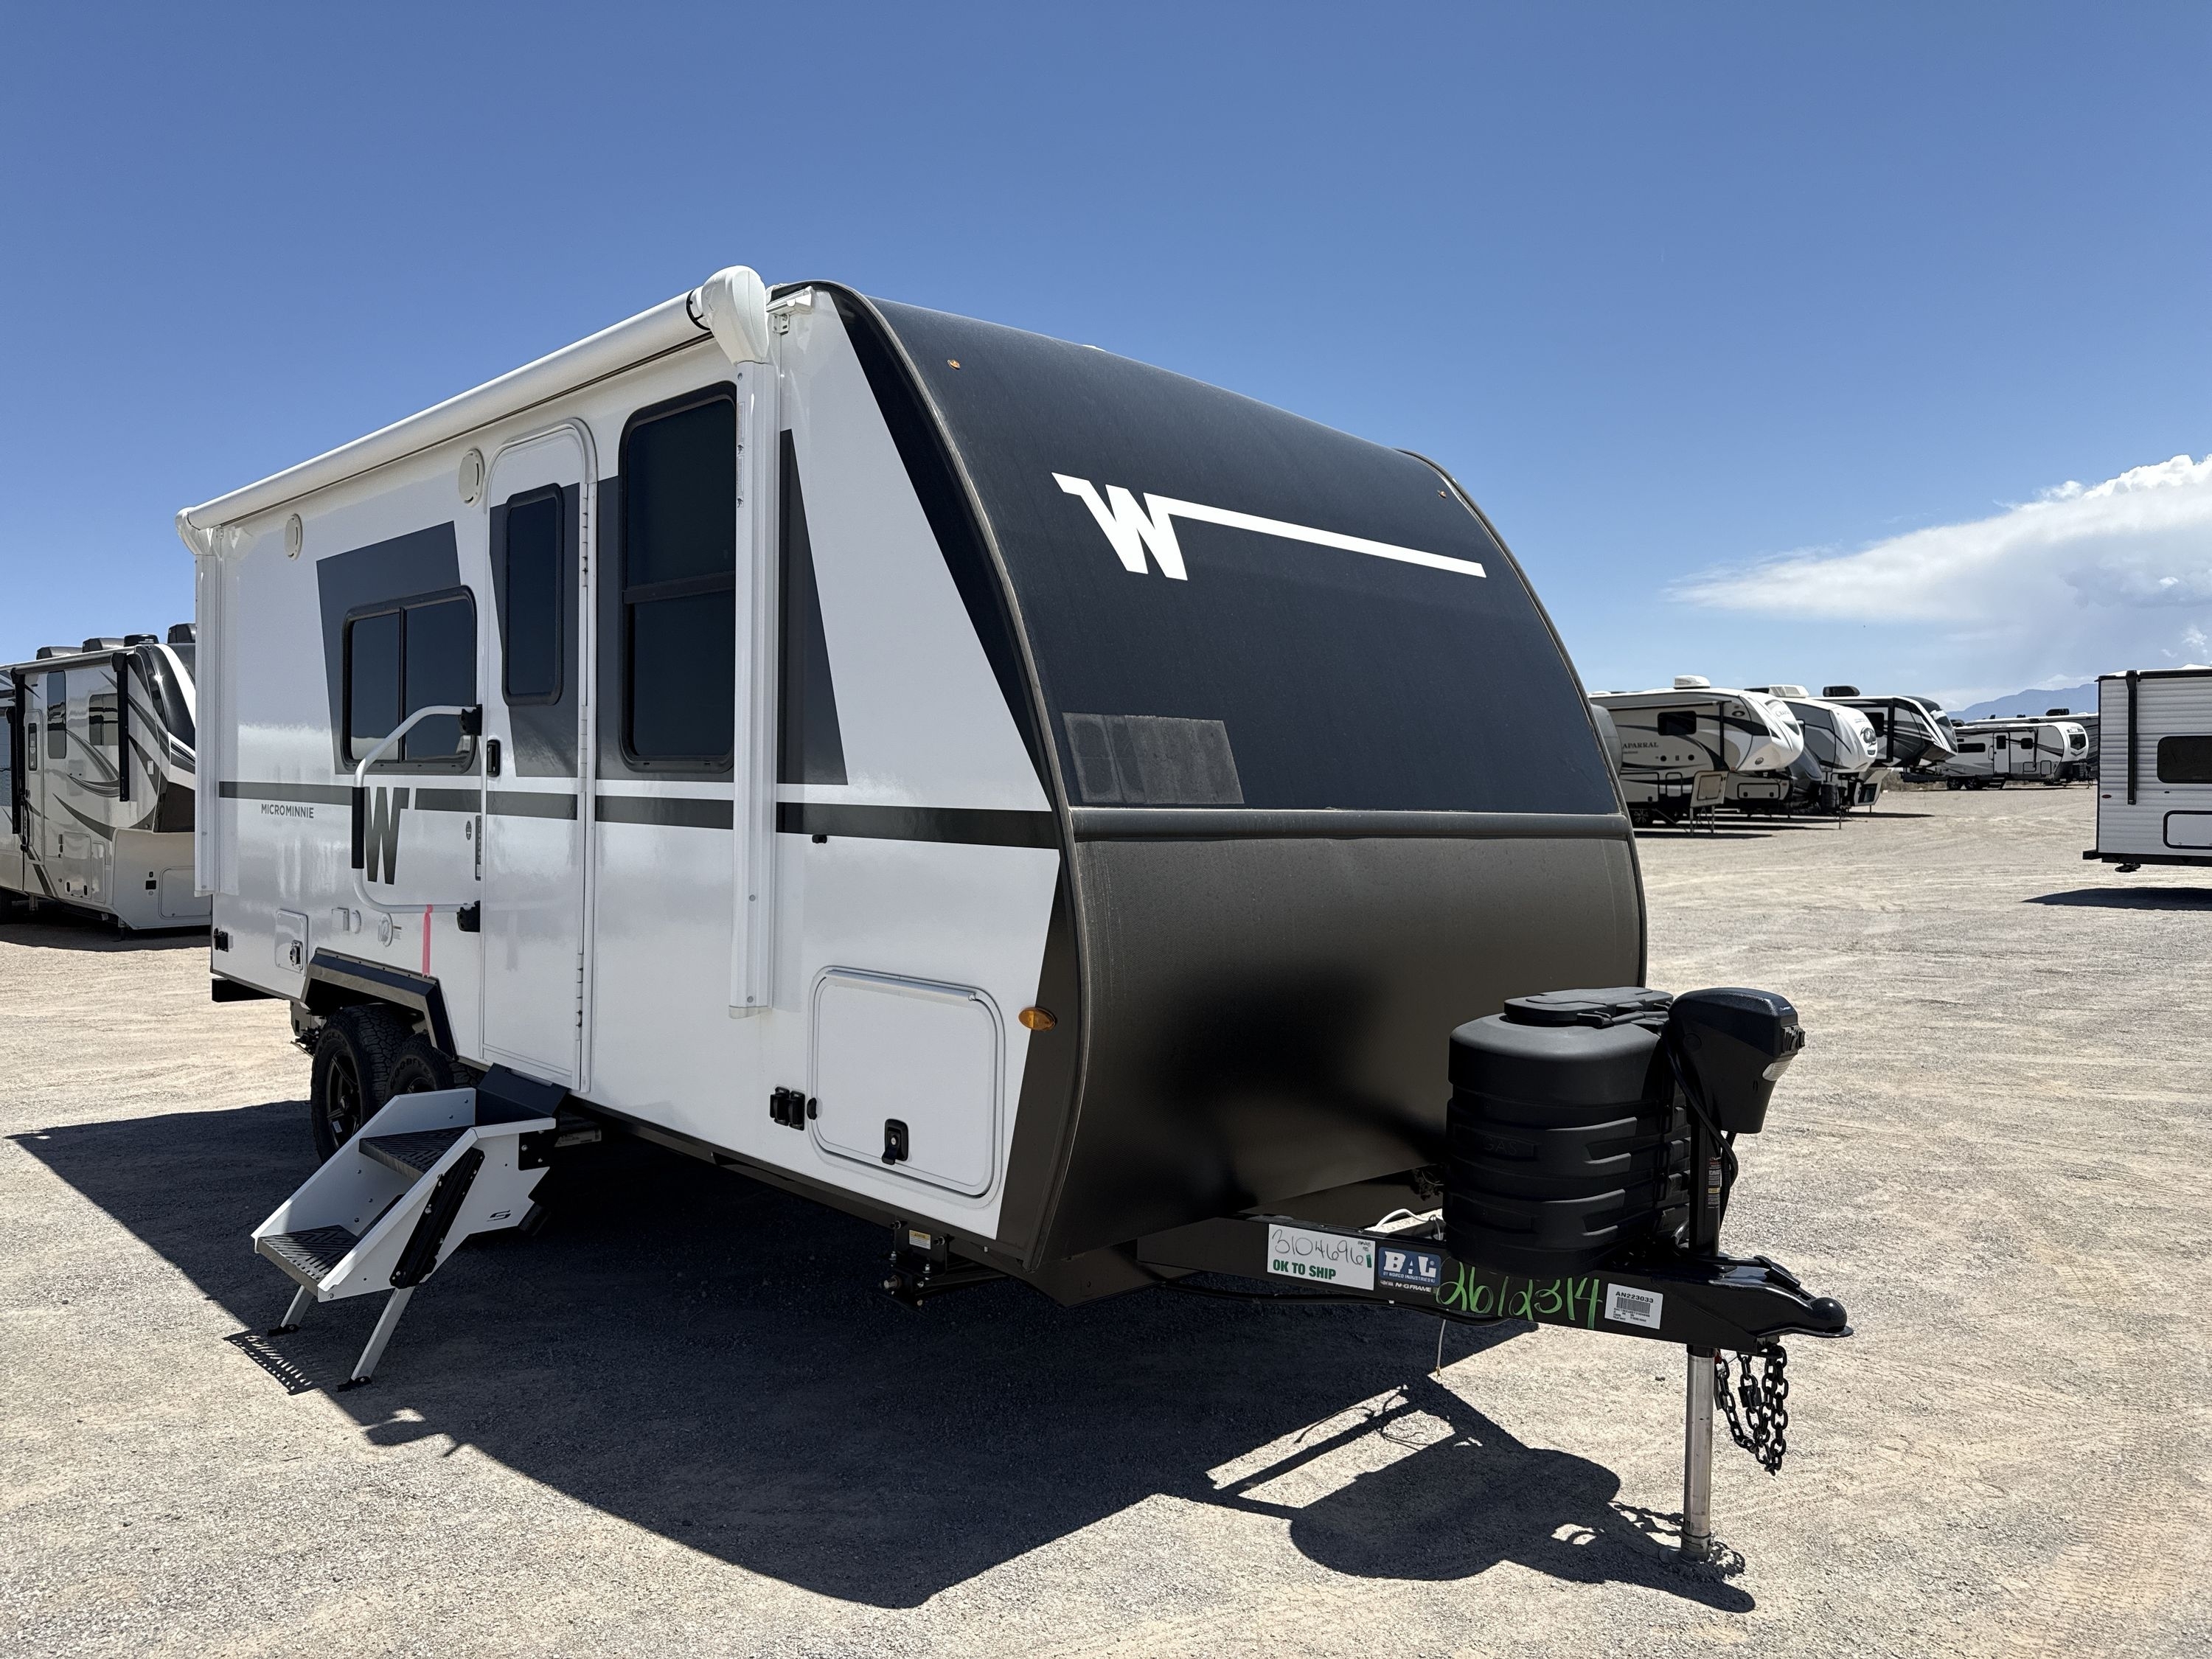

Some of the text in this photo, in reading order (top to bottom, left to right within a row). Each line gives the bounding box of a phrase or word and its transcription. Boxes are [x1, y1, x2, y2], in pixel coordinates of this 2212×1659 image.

[261, 804, 314, 818] MICROMINNIE
[1272, 1228, 1364, 1266] 3104696
[1273, 1259, 1337, 1280] OK TO SHIP
[1409, 1284, 1432, 1293] FRAME
[1615, 1291, 1654, 1304] AN223033
